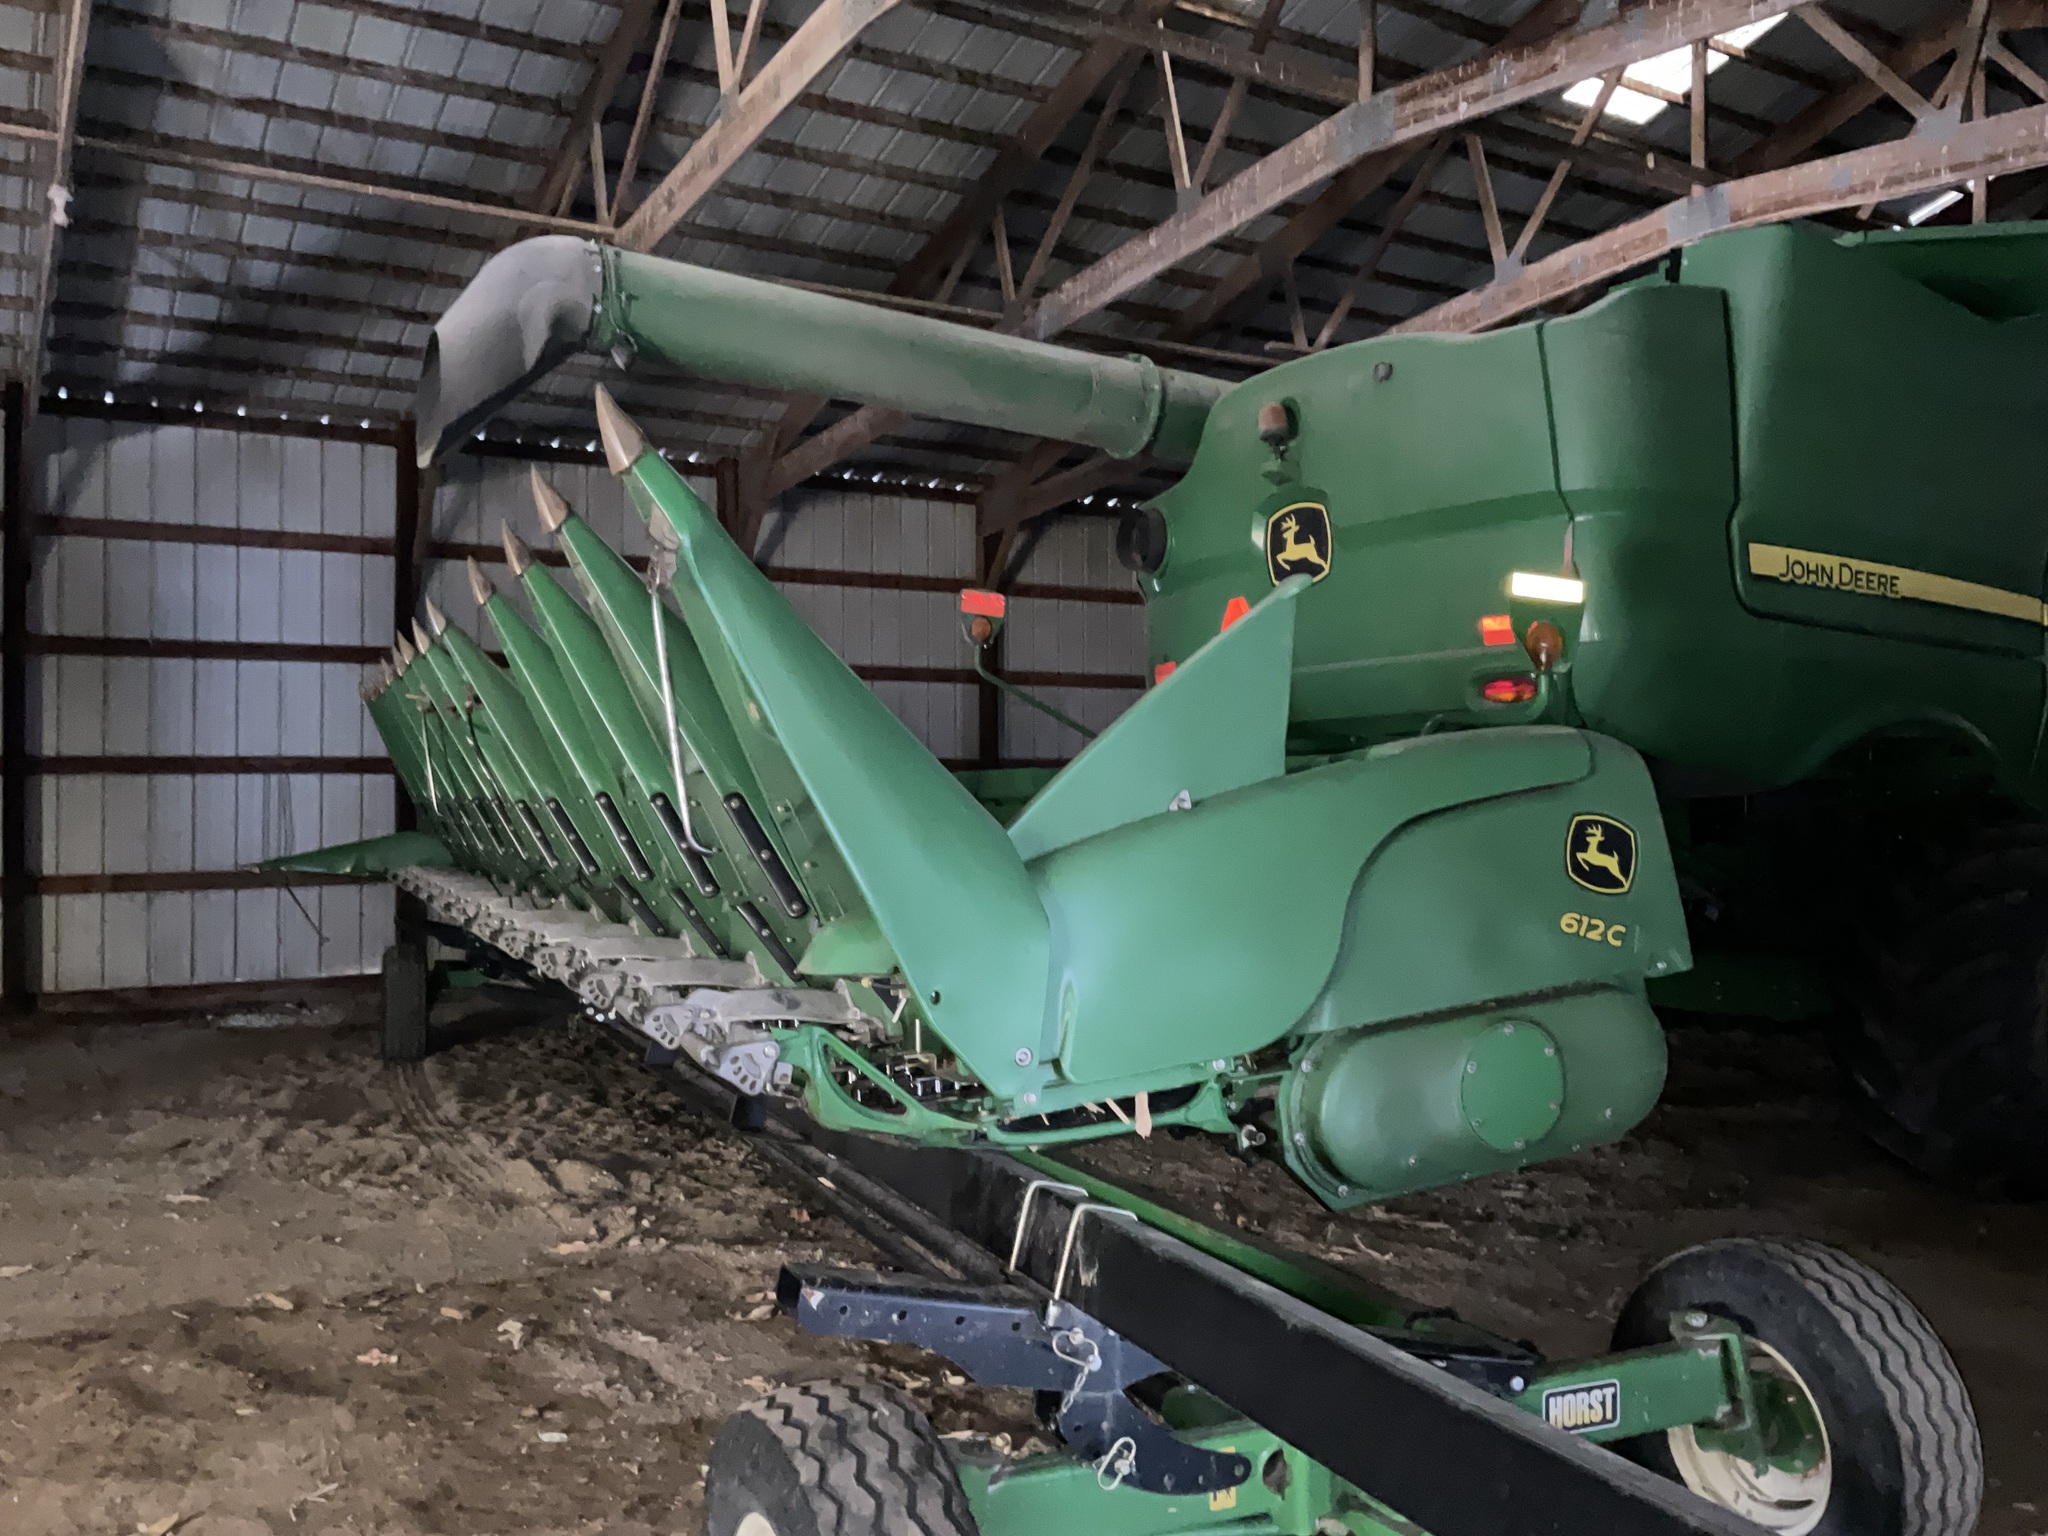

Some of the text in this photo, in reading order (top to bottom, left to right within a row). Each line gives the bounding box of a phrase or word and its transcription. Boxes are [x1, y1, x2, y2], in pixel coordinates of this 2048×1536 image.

[1779, 554, 1900, 595] JOHN DEERE
[1560, 912, 1626, 947] 612C
[1549, 1387, 1615, 1429] HORST
